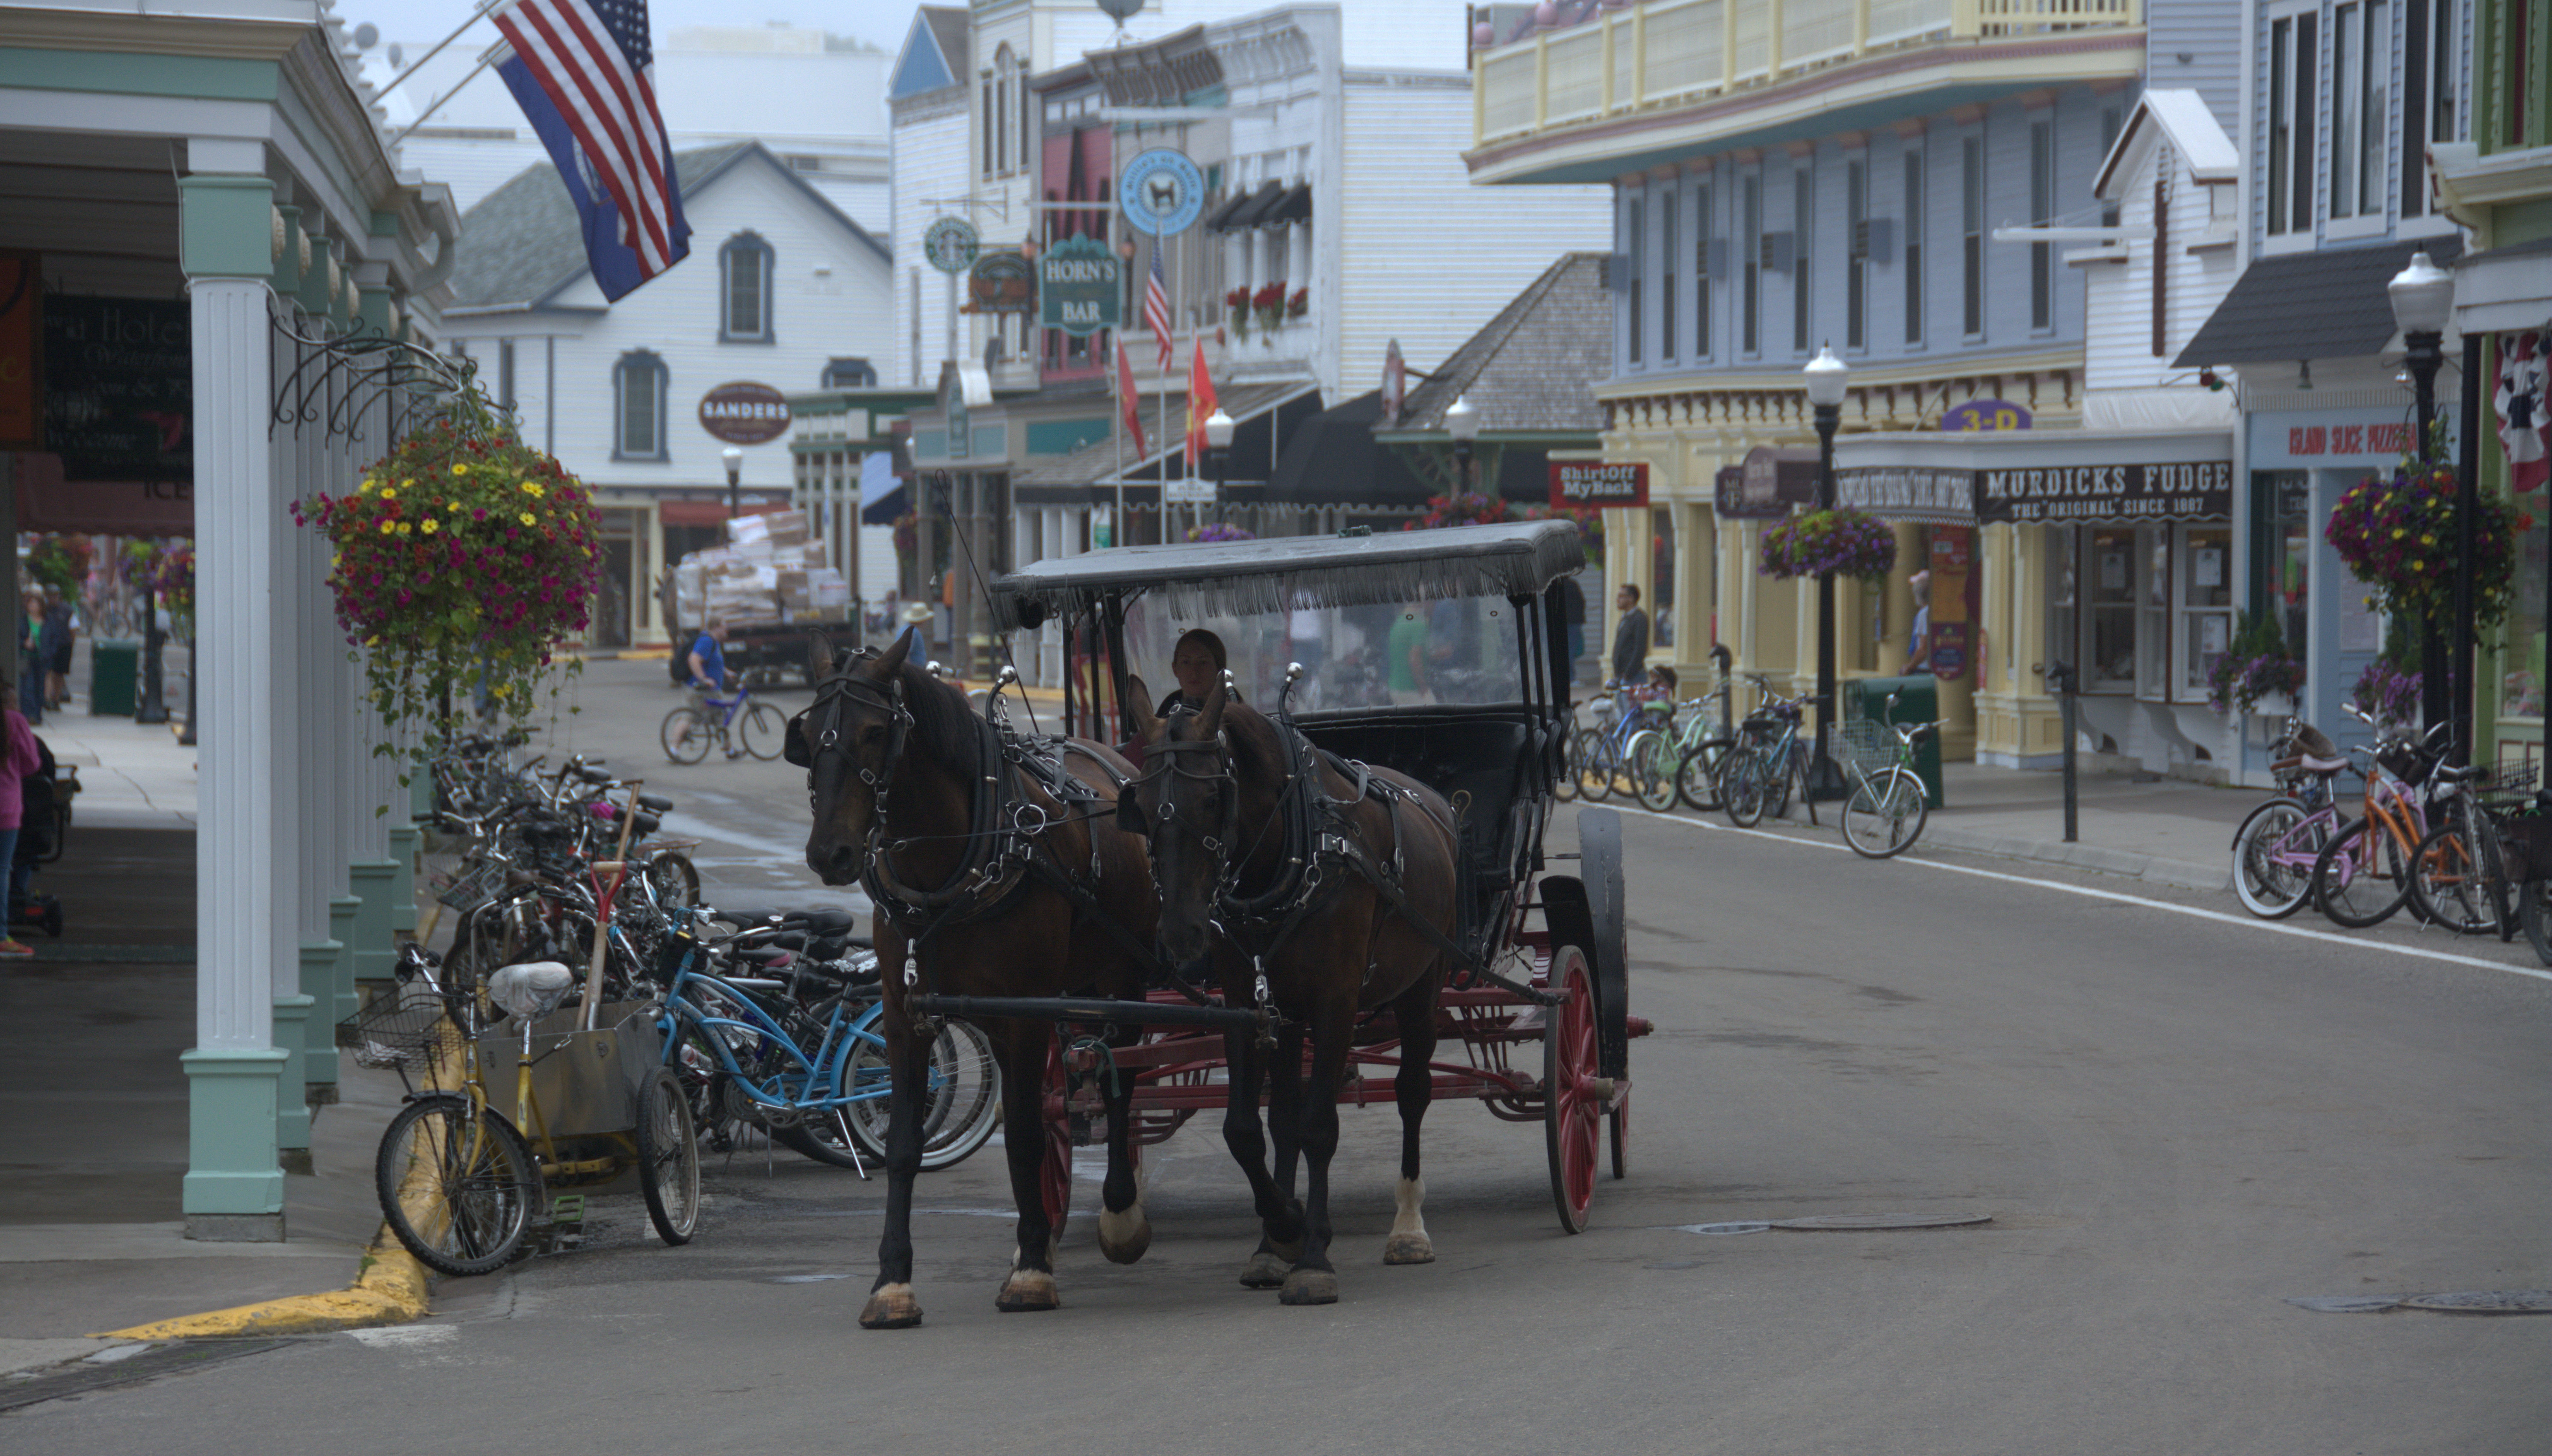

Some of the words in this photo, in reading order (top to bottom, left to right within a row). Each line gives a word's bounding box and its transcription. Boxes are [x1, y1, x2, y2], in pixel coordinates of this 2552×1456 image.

[1046, 260, 1116, 282] HORN'S
[1062, 301, 1101, 323] BAR
[703, 401, 789, 419] SANDERS
[1962, 409, 2019, 431] 3-D
[2289, 426, 2327, 455] ISLAND
[2331, 424, 2363, 455] SLICE
[1986, 466, 2127, 498] MURDICKS
[2143, 463, 2230, 494] FUDGE
[2011, 502, 2041, 519] THE
[2123, 498, 2166, 515] SINCE
